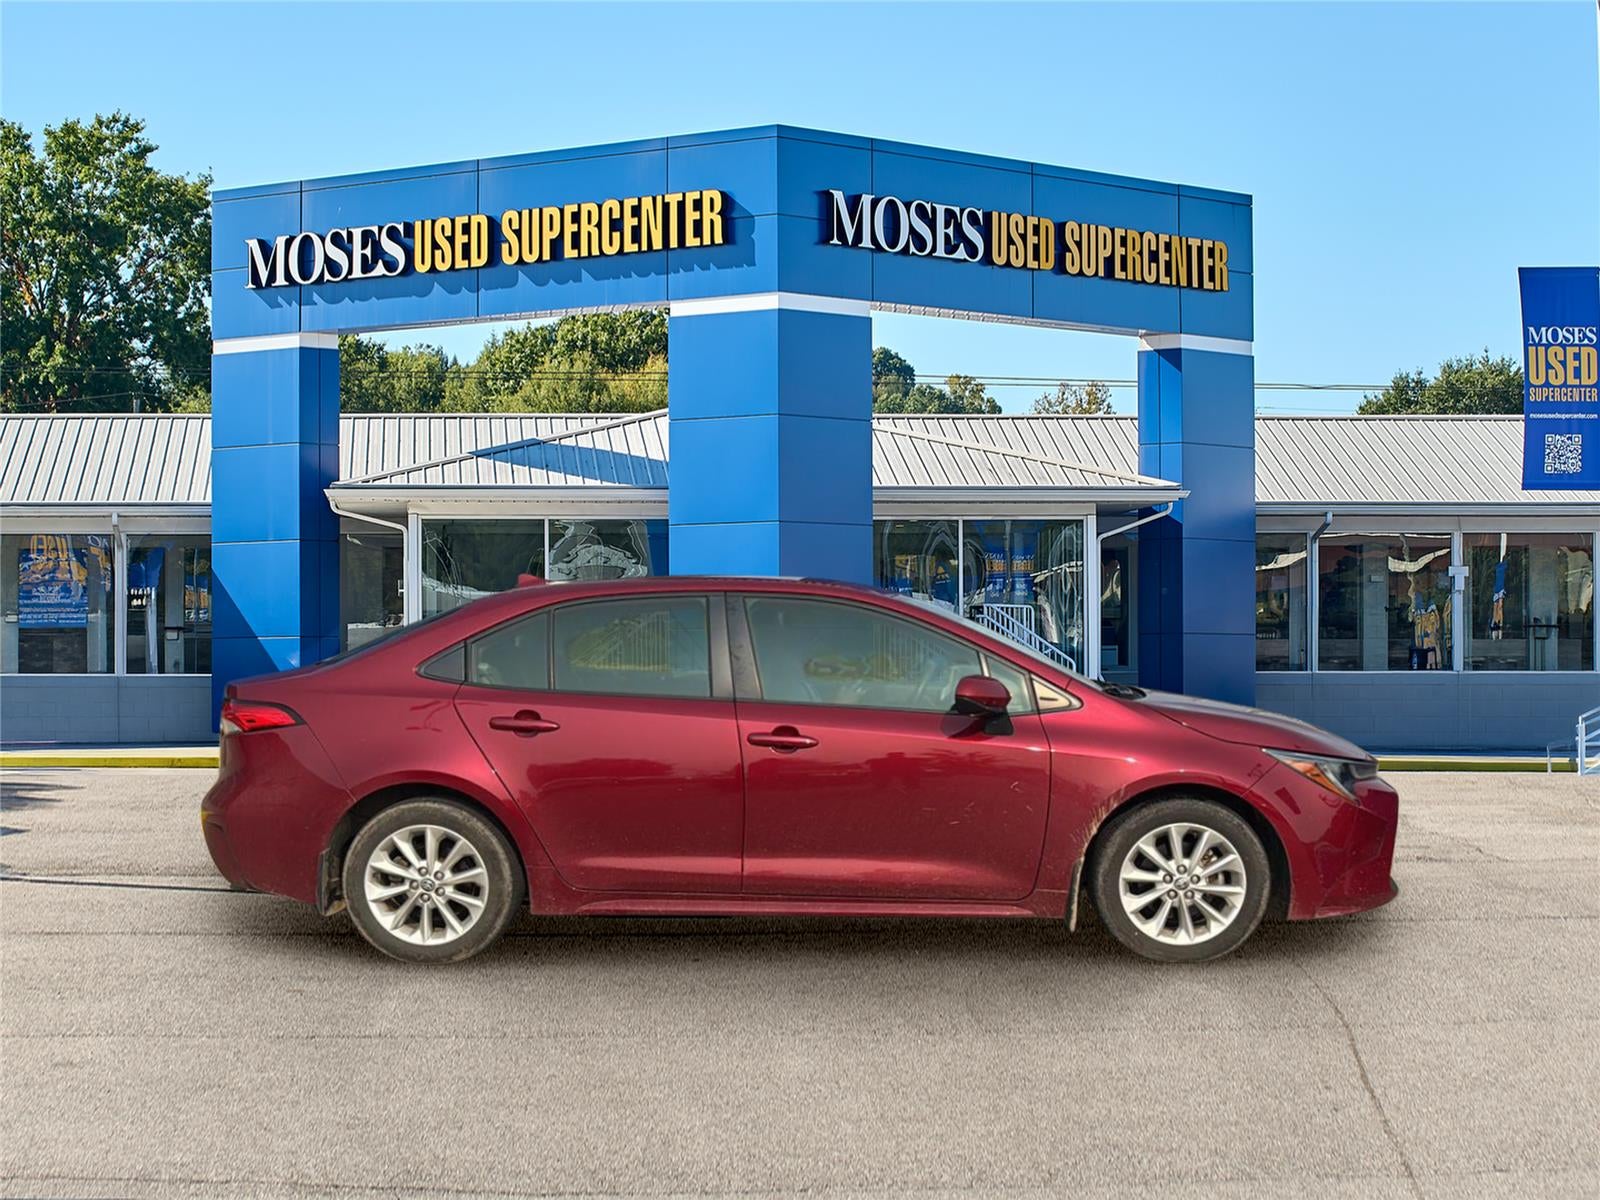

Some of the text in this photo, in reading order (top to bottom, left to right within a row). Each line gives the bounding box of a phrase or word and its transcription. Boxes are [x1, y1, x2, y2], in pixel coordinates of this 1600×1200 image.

[243, 189, 725, 289] MOSES USED SUPERCENTER
[828, 188, 1230, 292] MOSES USED SUPERCENTER
[1527, 326, 1597, 344] MOSES
[1528, 346, 1598, 385] USED
[1529, 387, 1598, 402] SUPERCENTER
[1529, 412, 1598, 420] mosesusedsupercenter.com
